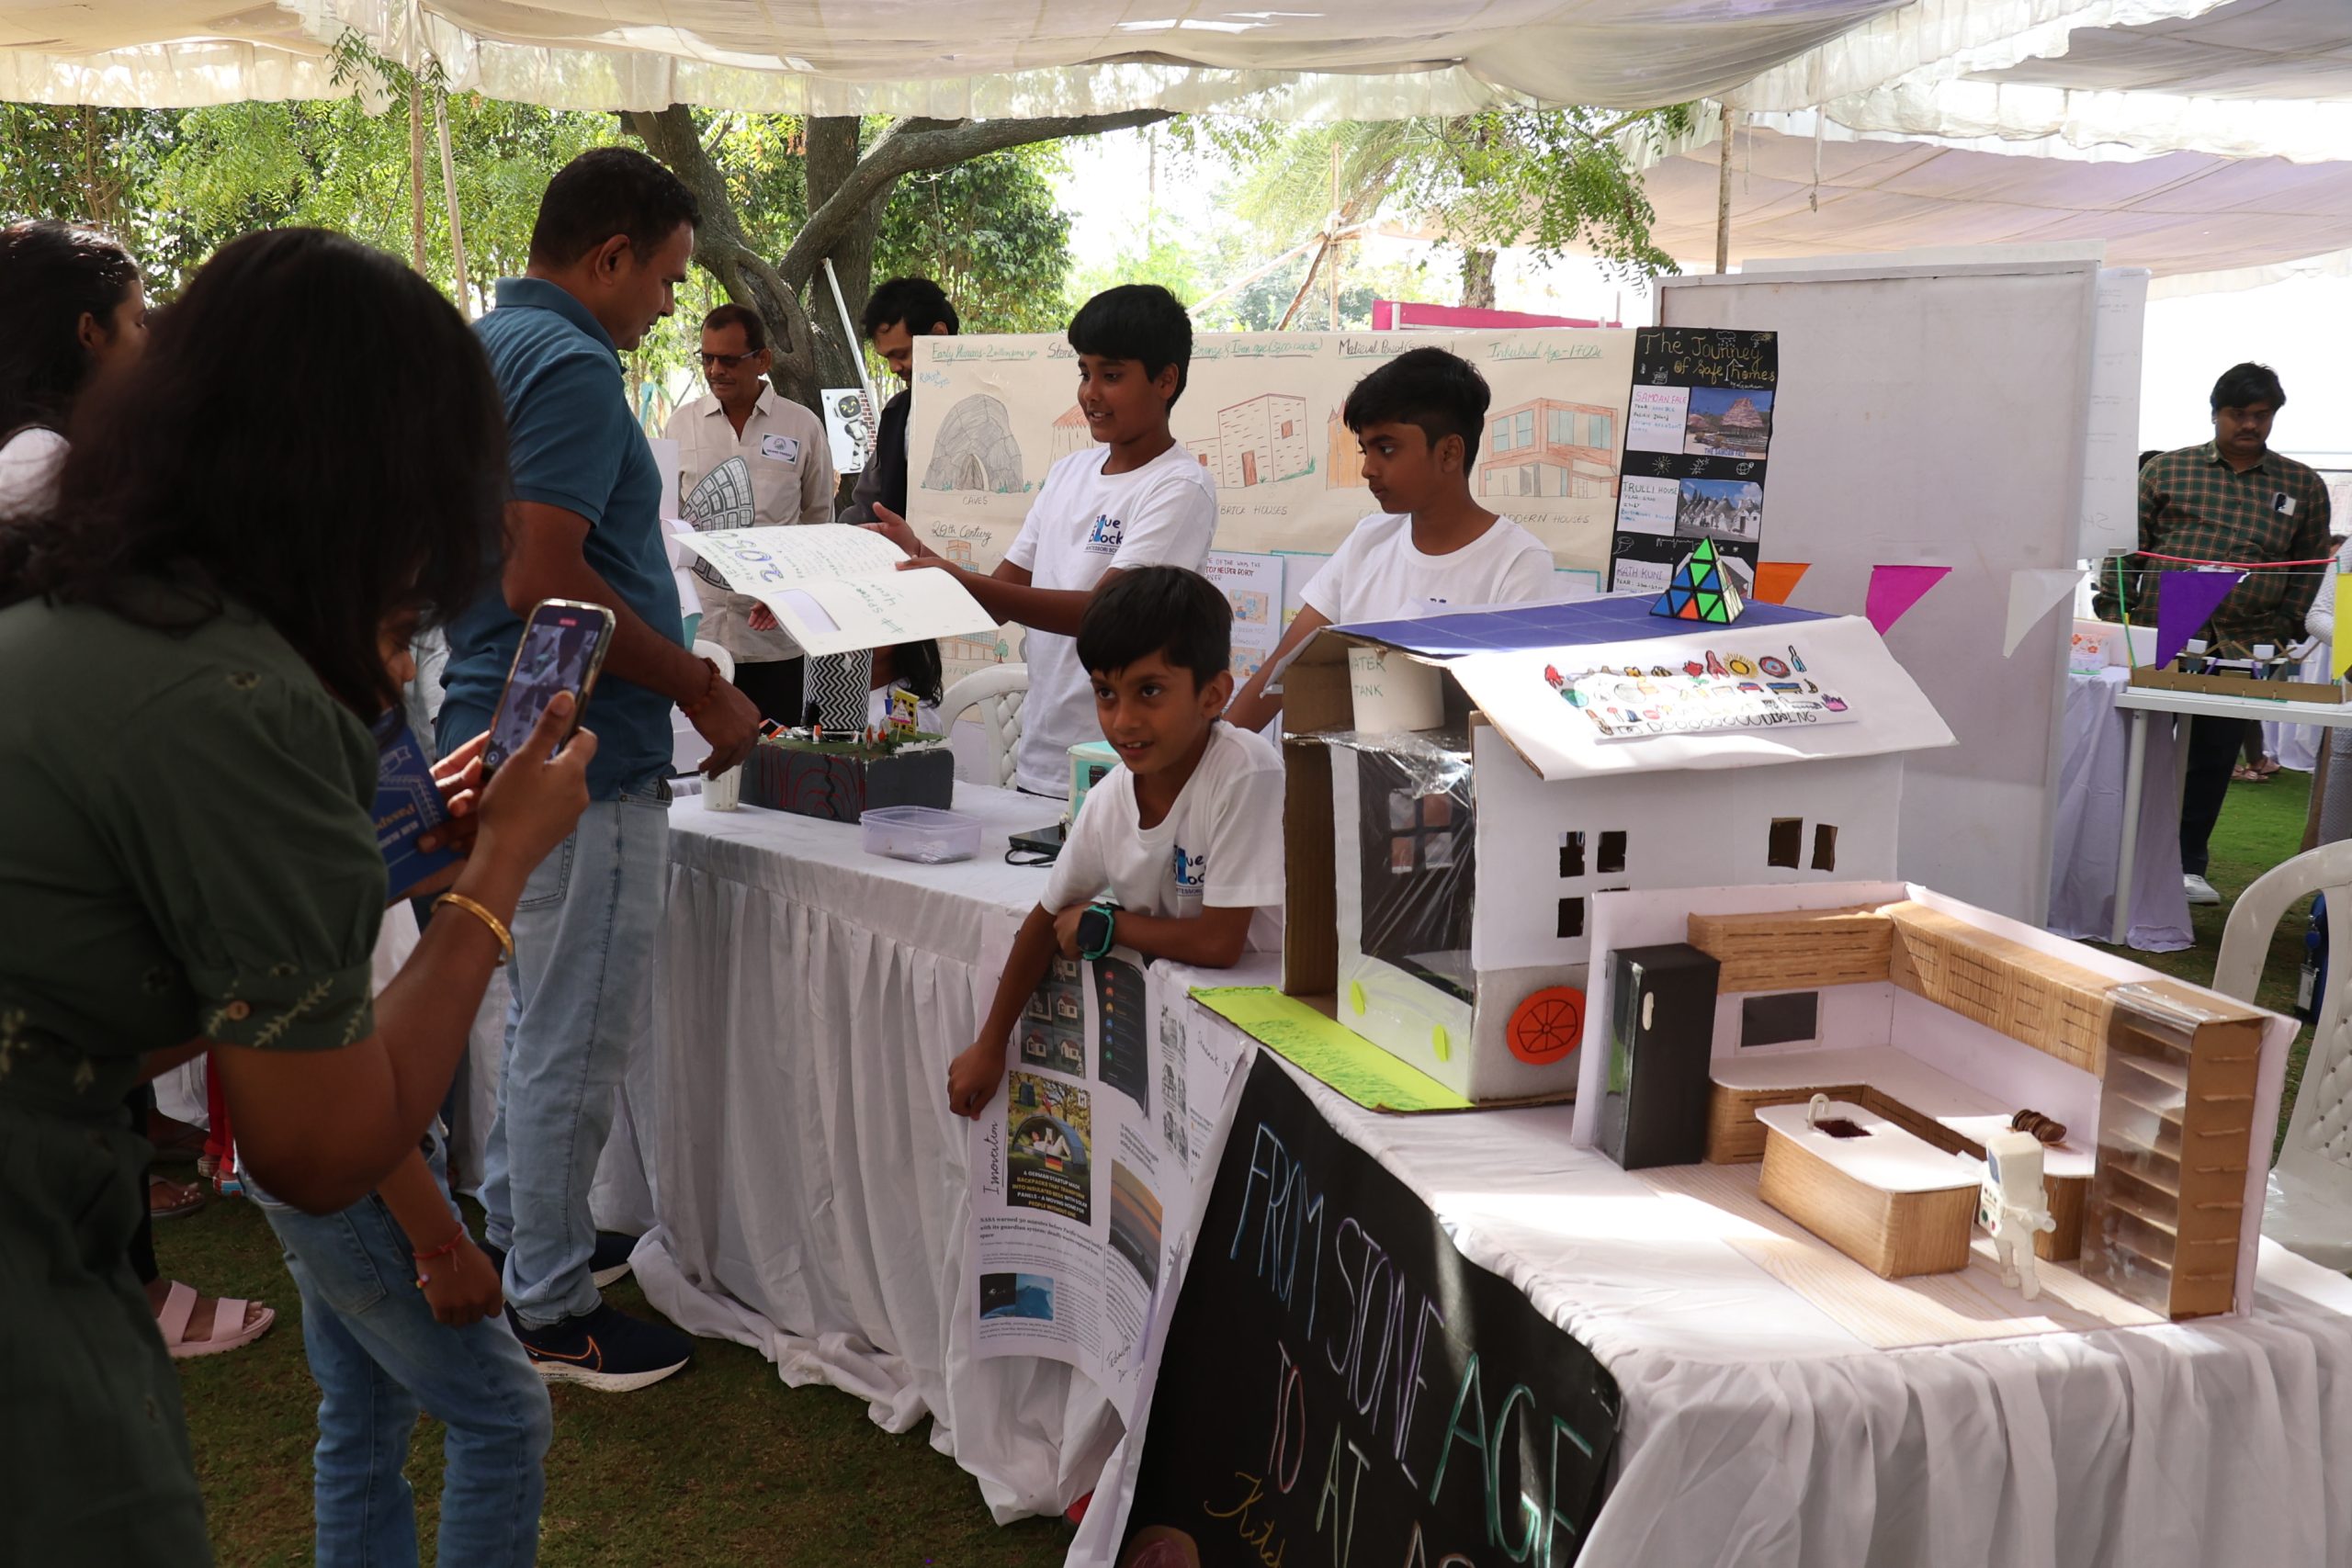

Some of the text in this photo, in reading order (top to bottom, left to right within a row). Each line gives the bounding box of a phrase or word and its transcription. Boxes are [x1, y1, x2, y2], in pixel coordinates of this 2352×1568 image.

[1339, 338, 1378, 355] Medieval
[1638, 332, 1683, 355] The
[932, 343, 954, 365] Early
[1623, 482, 1679, 495] TRULLI HOUSE
[963, 496, 989, 505] CAVES
[1220, 505, 1288, 514] BRICK HOUSES
[1554, 514, 1590, 524] HOUSES
[1617, 564, 1663, 580] KATH KUNI
[1353, 683, 1383, 697] TANK
[1049, 1176, 1069, 1185] STARTUP
[1430, 1351, 1594, 1568] AGE
